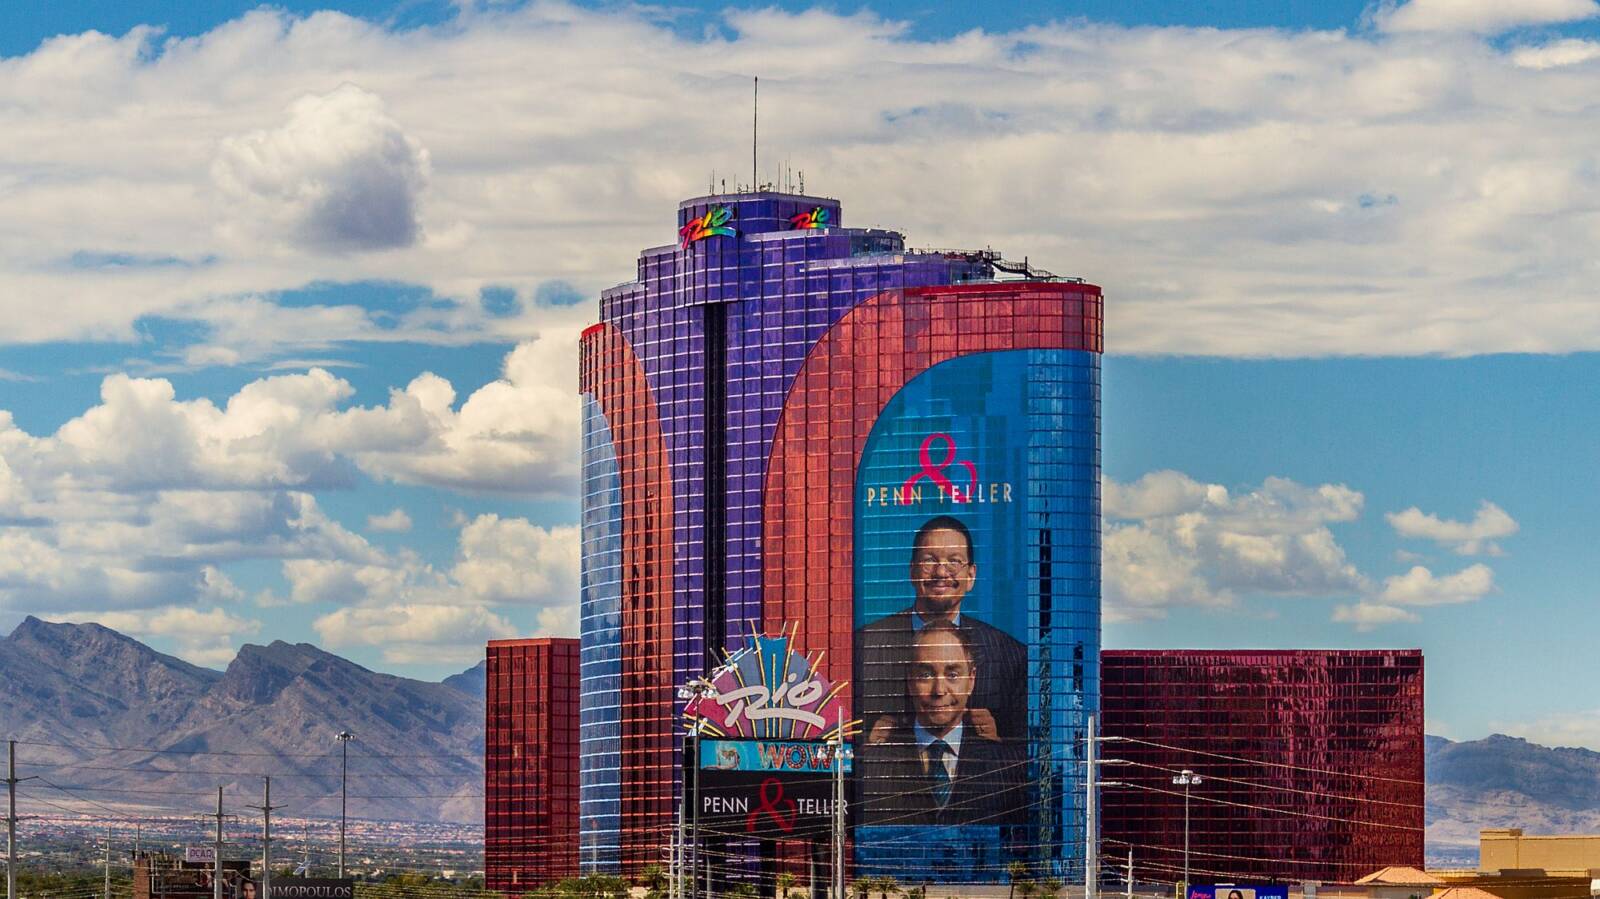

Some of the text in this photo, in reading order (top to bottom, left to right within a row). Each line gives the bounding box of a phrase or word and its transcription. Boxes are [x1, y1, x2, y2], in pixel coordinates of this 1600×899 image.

[679, 206, 737, 249] Rio
[789, 206, 834, 230] Rio
[867, 486, 922, 507] PENN
[938, 482, 1013, 504] TELLER
[716, 672, 826, 730] Rio
[757, 742, 835, 769] WOW
[703, 796, 748, 813] PENN
[269, 885, 352, 898] IMOPOULOS
